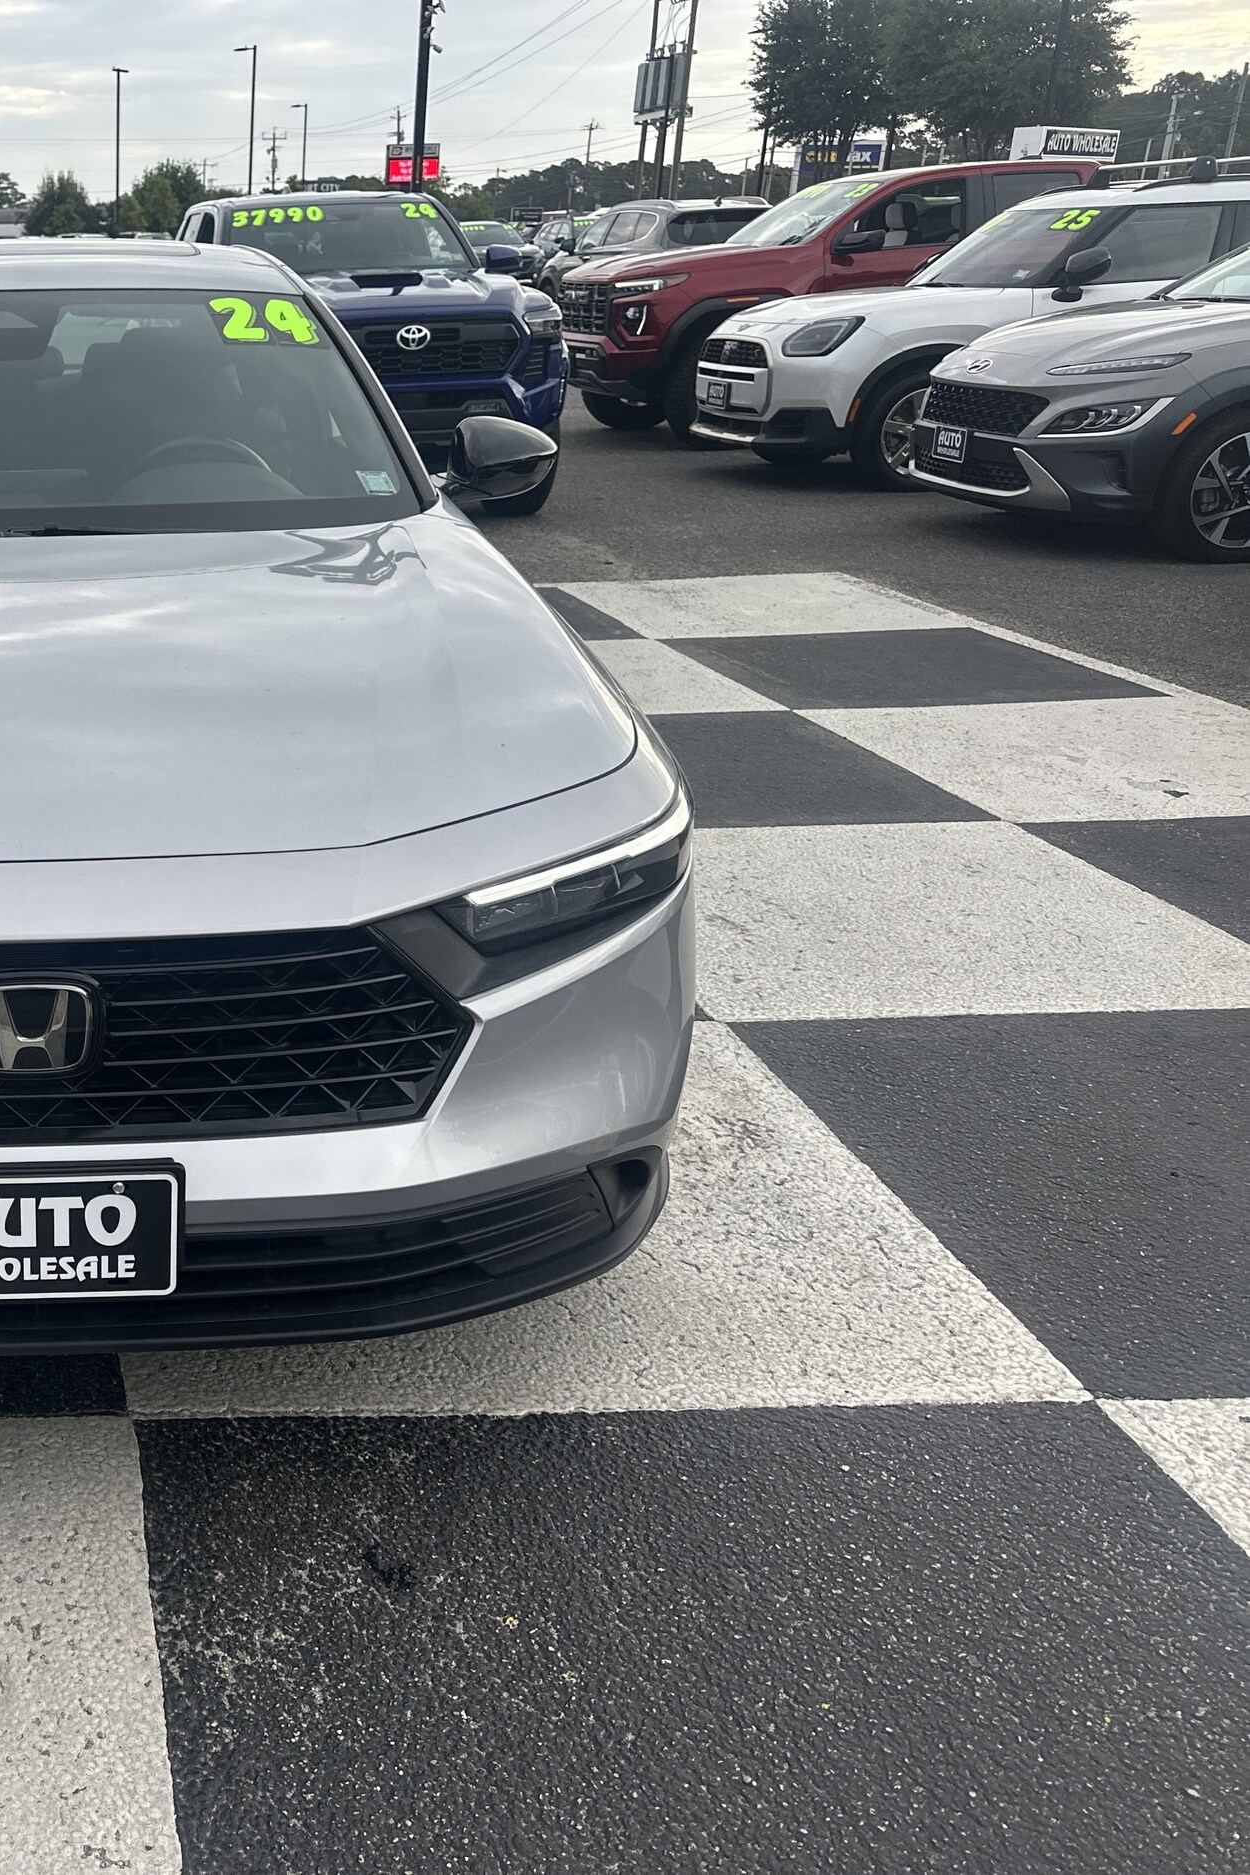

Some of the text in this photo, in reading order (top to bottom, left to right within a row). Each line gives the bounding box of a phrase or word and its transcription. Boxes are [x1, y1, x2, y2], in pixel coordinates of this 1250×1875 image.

[1047, 133, 1116, 153] AUTO WHOLESALE
[321, 182, 341, 192] CITY
[232, 206, 325, 227] 37990
[401, 203, 439, 219] 24
[1050, 209, 1101, 231] 25
[208, 297, 319, 345] 24
[938, 430, 962, 448] AUTO
